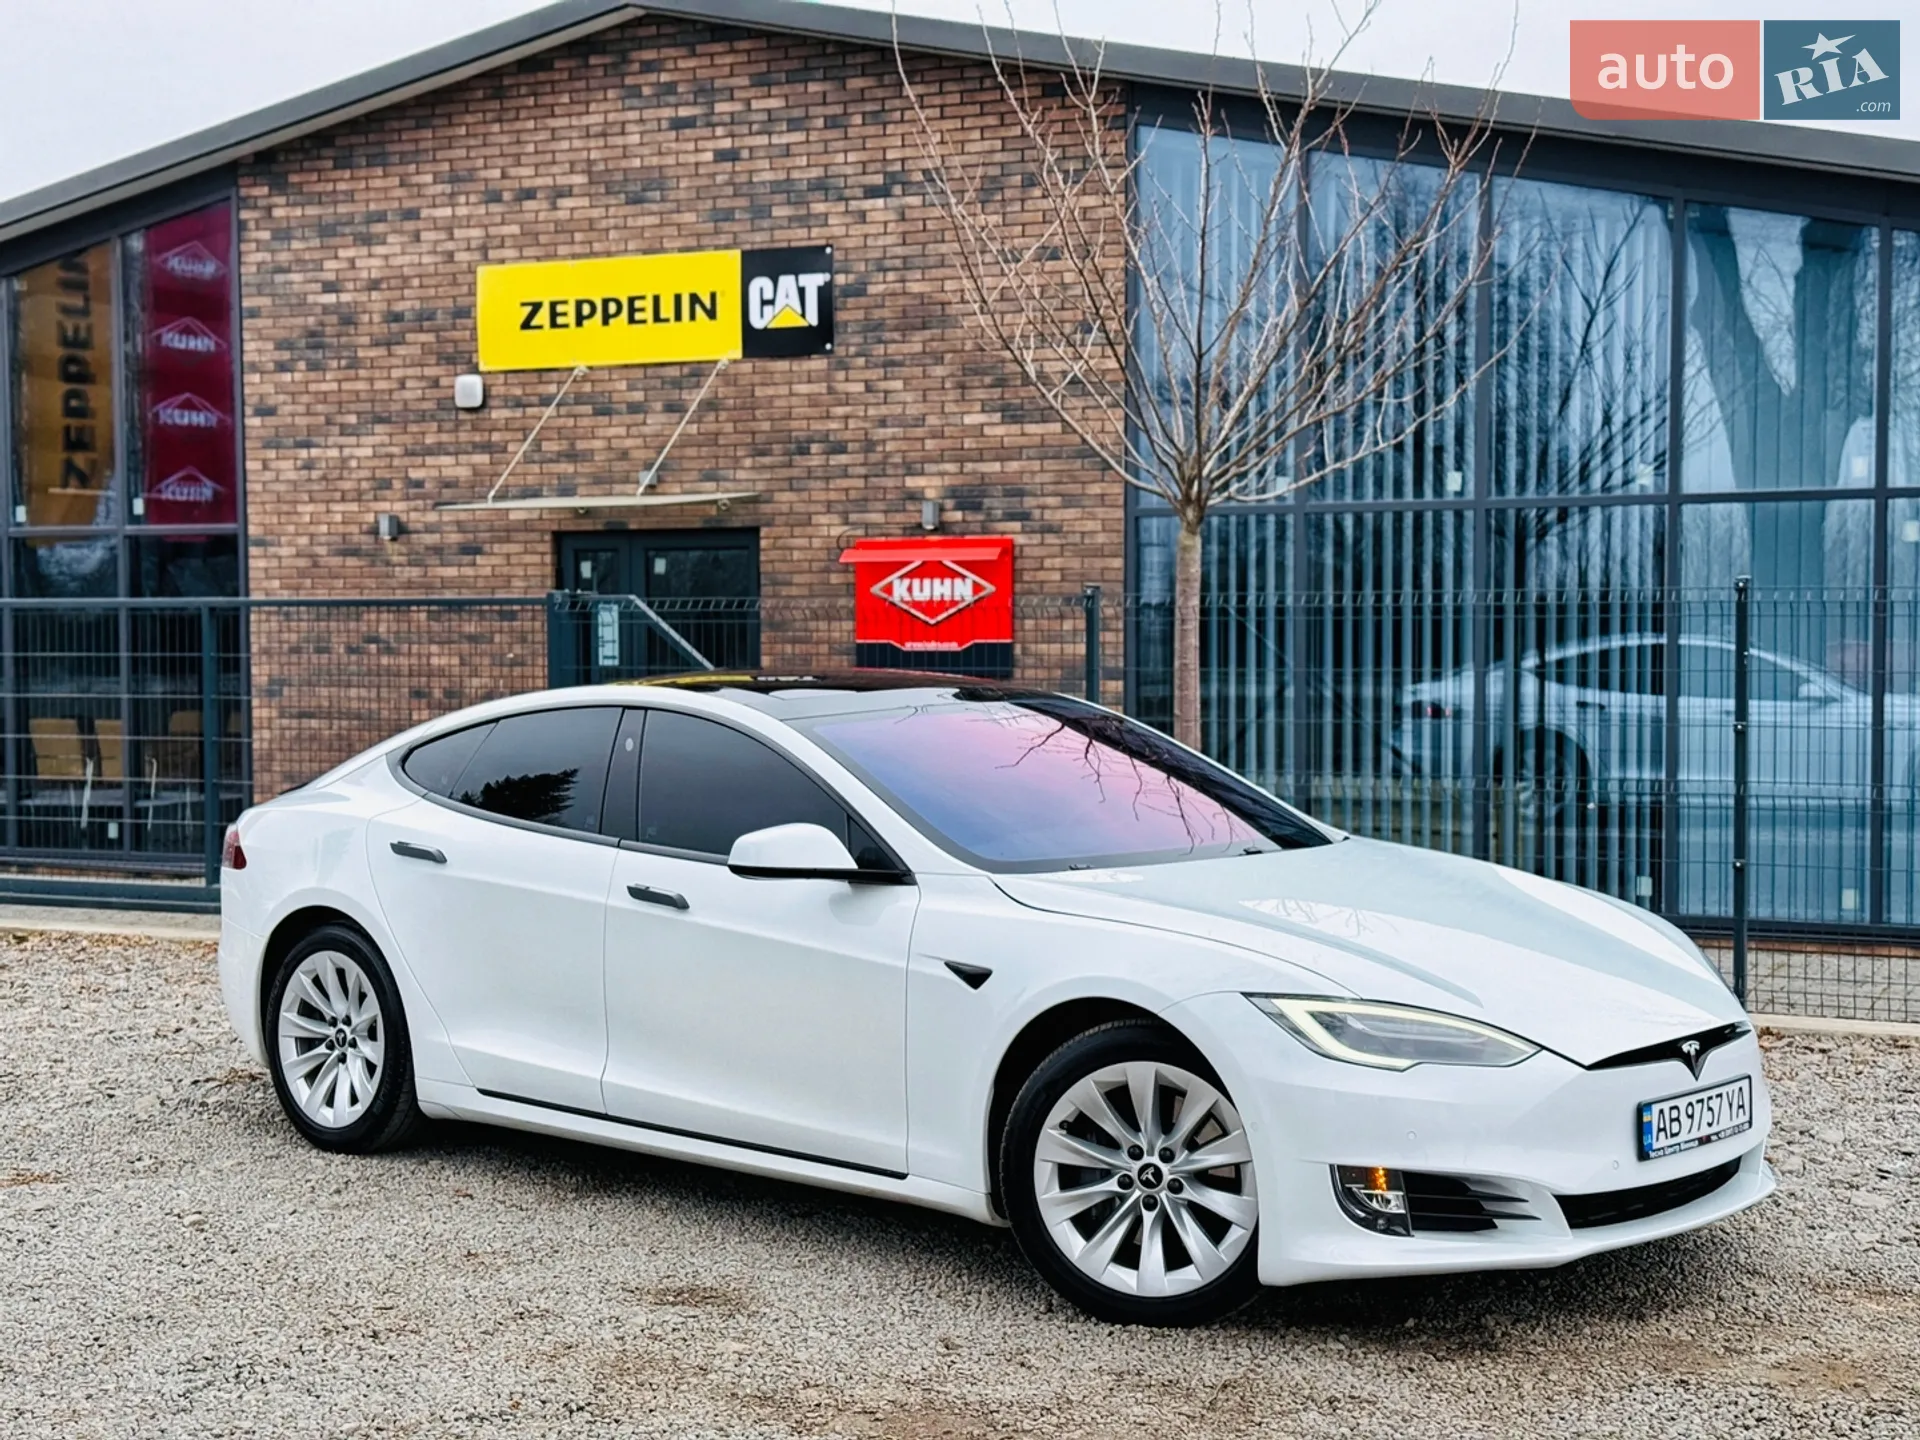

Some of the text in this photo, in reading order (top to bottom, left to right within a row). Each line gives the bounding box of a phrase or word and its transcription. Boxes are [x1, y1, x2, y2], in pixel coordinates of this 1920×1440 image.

[519, 291, 718, 331] ZEPPELIN
[748, 273, 830, 329] CAT
[892, 577, 973, 602] KUHN
[1656, 1105, 1682, 1142] AB
[1685, 1092, 1723, 1134] 9757
[1726, 1086, 1746, 1121] YA
